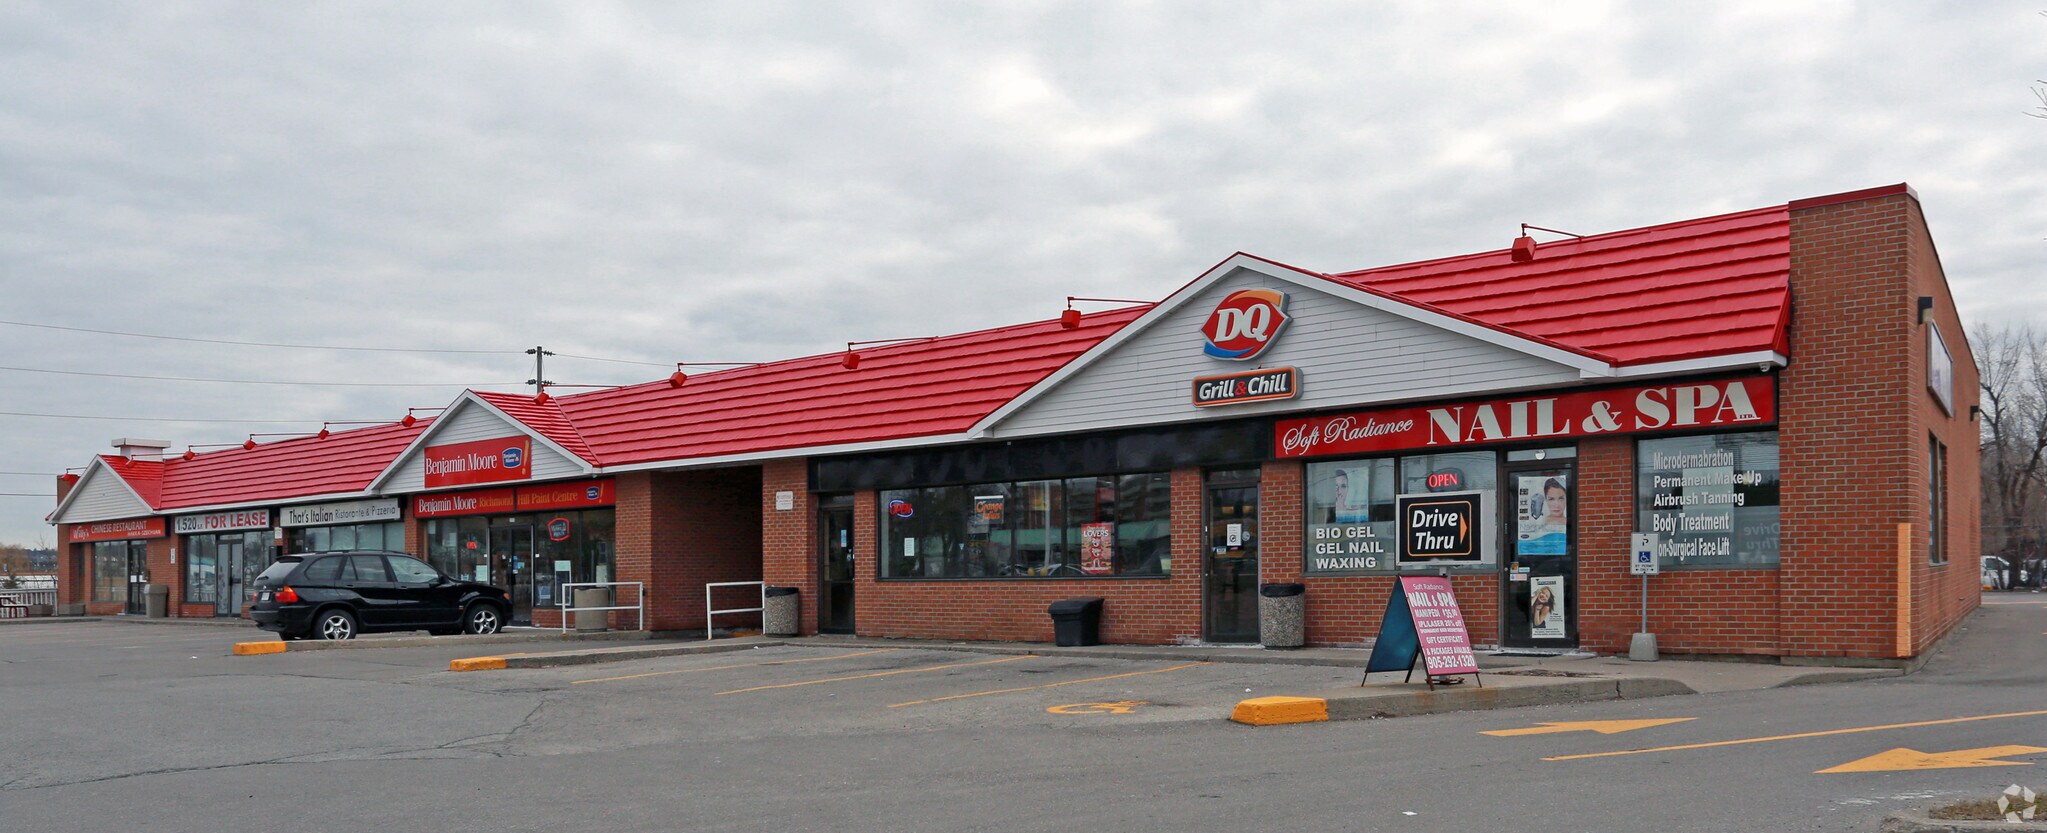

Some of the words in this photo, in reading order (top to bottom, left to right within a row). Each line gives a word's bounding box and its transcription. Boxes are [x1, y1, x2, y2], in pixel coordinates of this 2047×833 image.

[1213, 303, 1271, 342] DQ
[1199, 379, 1235, 400] Grill
[1235, 381, 1247, 395] &
[1248, 373, 1287, 395] Chill
[1283, 423, 1319, 455] Soft
[1324, 416, 1413, 444] Radiance
[1426, 398, 1571, 445] NAIL
[1582, 400, 1623, 433] &
[1635, 381, 1761, 430] SPA
[426, 456, 466, 477] Benjamin
[468, 452, 497, 471] Moore
[1653, 449, 1734, 470] Microdermabration
[1428, 472, 1459, 488] OPEN
[1654, 474, 1711, 488] Permanent
[1714, 472, 1743, 486] Make
[1746, 470, 1762, 487] Up
[418, 497, 451, 514] Benjamin
[453, 496, 477, 510] Moore
[479, 495, 513, 507] Richmond
[517, 494, 530, 505] Hill
[532, 493, 550, 504] Paint
[552, 491, 578, 502] Centre
[1654, 492, 1698, 507] Airbrush
[1701, 490, 1745, 507] Tanning
[205, 515, 227, 529] FOR
[230, 511, 267, 527] LEASE
[289, 509, 309, 524] That's
[310, 507, 334, 522] Italian
[335, 508, 365, 519] Ristorante
[371, 504, 396, 516] Pizzeria
[1412, 508, 1459, 528] Drive
[91, 523, 112, 534] CHINESE
[113, 520, 147, 532] RESTAURANT
[1316, 527, 1342, 539] BIO
[1345, 526, 1376, 539] GEL
[1653, 513, 1677, 536] Body
[1679, 512, 1730, 531] Treatment
[1083, 529, 1109, 538] LOVERS
[1415, 531, 1454, 550] Thru
[1316, 542, 1345, 554] GEL
[1349, 541, 1384, 553] NAIL
[1658, 537, 1697, 561] on-Surgical
[1699, 538, 1716, 556] Face
[1717, 537, 1730, 556] Lift
[1316, 556, 1376, 569] WAXING
[1408, 592, 1431, 607] NAIL
[1437, 592, 1456, 607] SPA
[1430, 646, 1453, 654] PACKAGES
[1428, 655, 1476, 668] 905-292-1320
